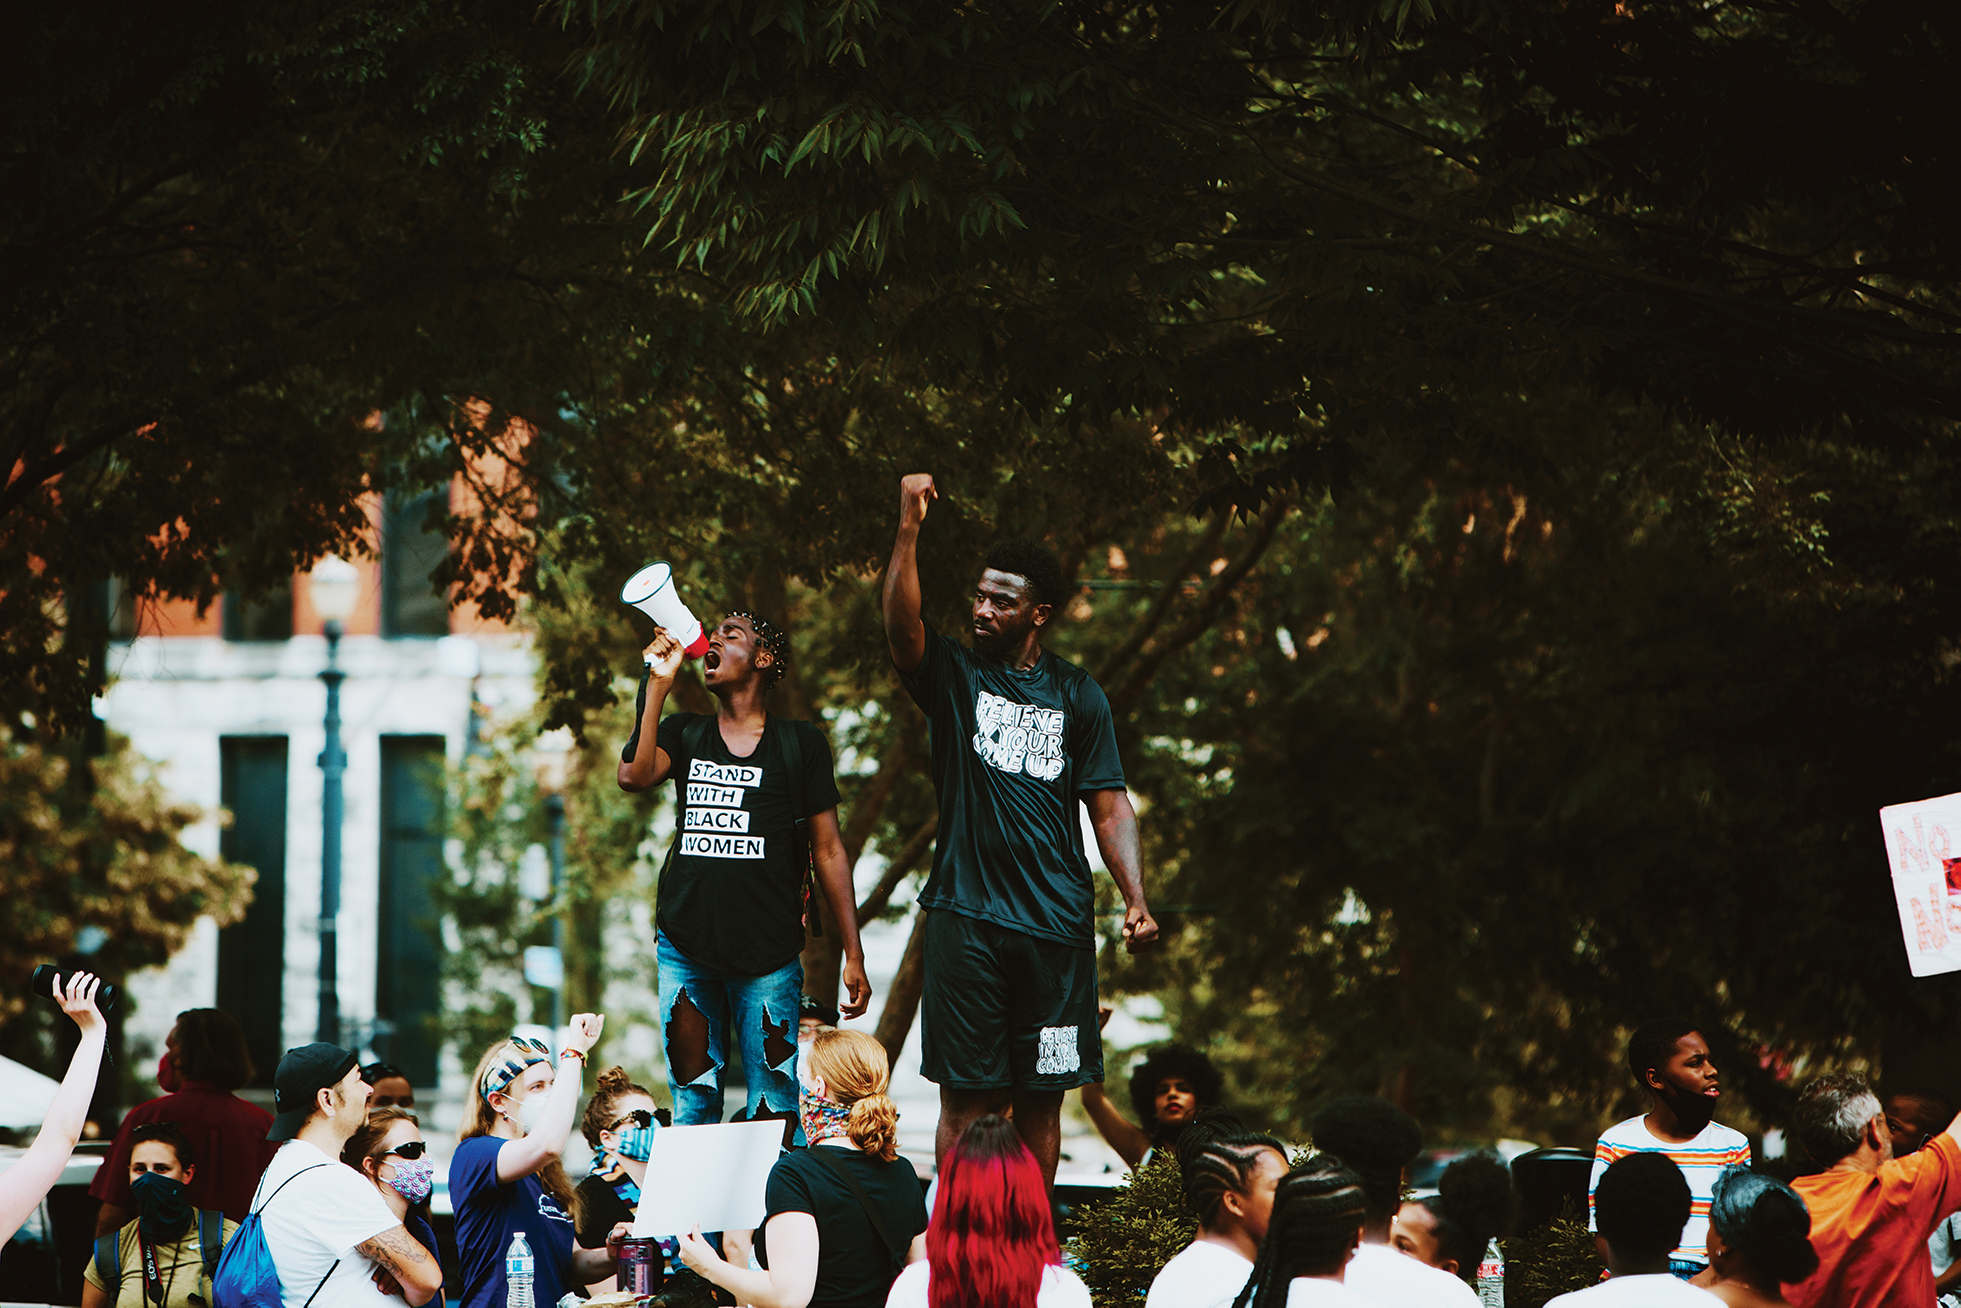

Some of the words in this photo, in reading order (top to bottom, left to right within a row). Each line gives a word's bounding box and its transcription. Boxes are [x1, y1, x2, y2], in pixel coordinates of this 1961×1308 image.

[977, 691, 1064, 735] BELIEVE
[999, 724, 1063, 758] YOUR
[691, 762, 756, 782] STAND
[1025, 753, 1065, 782] UP
[688, 786, 736, 803] WITH
[686, 811, 743, 829] BLACK
[684, 836, 761, 856] WOMEN
[1040, 1026, 1079, 1044] BELIEVE
[146, 1260, 157, 1280] EOS
